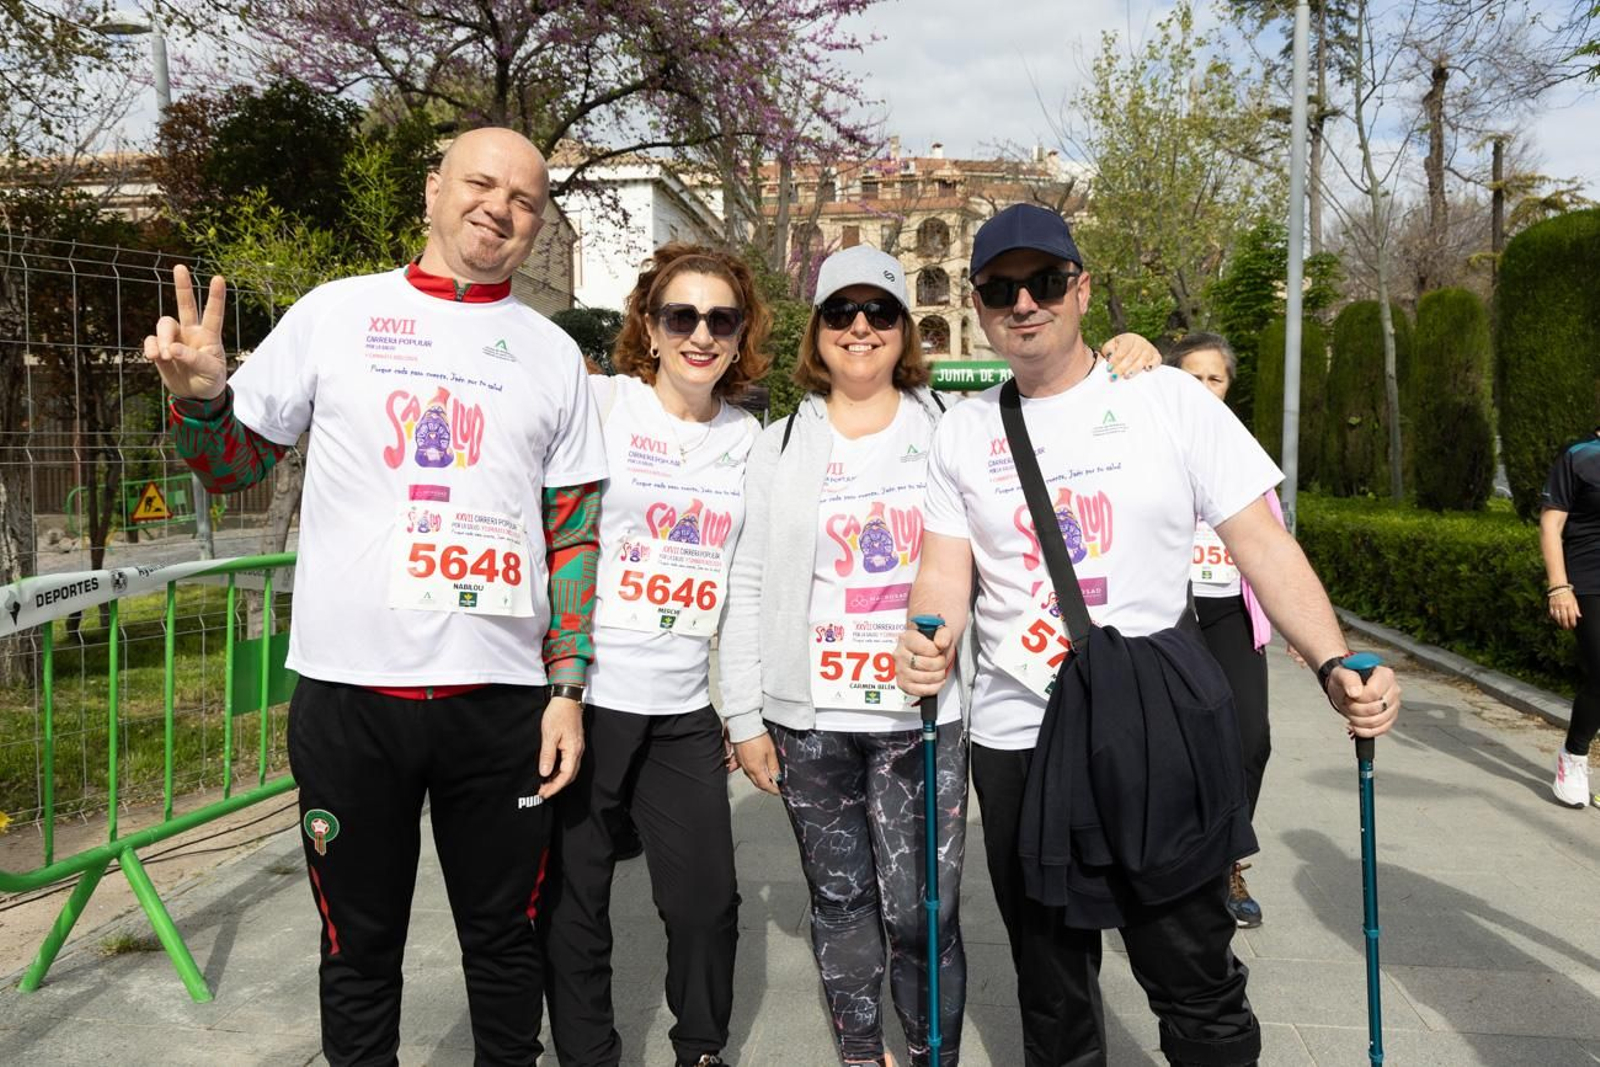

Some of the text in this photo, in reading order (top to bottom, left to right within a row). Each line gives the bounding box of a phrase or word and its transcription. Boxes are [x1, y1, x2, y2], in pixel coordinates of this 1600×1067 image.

[366, 336, 433, 347] CARRERA POPULAR
[368, 316, 416, 335] XXVII
[937, 368, 974, 382] JUNTA
[980, 368, 994, 382] DE
[384, 389, 484, 469] SALUD
[630, 433, 668, 455] XXVII
[988, 457, 1014, 467] CARRER
[990, 438, 1007, 456] XX
[826, 505, 925, 577] SALUD
[1014, 490, 1114, 571] SLUD
[407, 542, 522, 587] 5648
[1192, 545, 1234, 566] 058
[35, 576, 99, 608] DEPORTES
[618, 570, 718, 611] 5646
[1021, 618, 1072, 668] 57
[819, 651, 897, 683] 579
